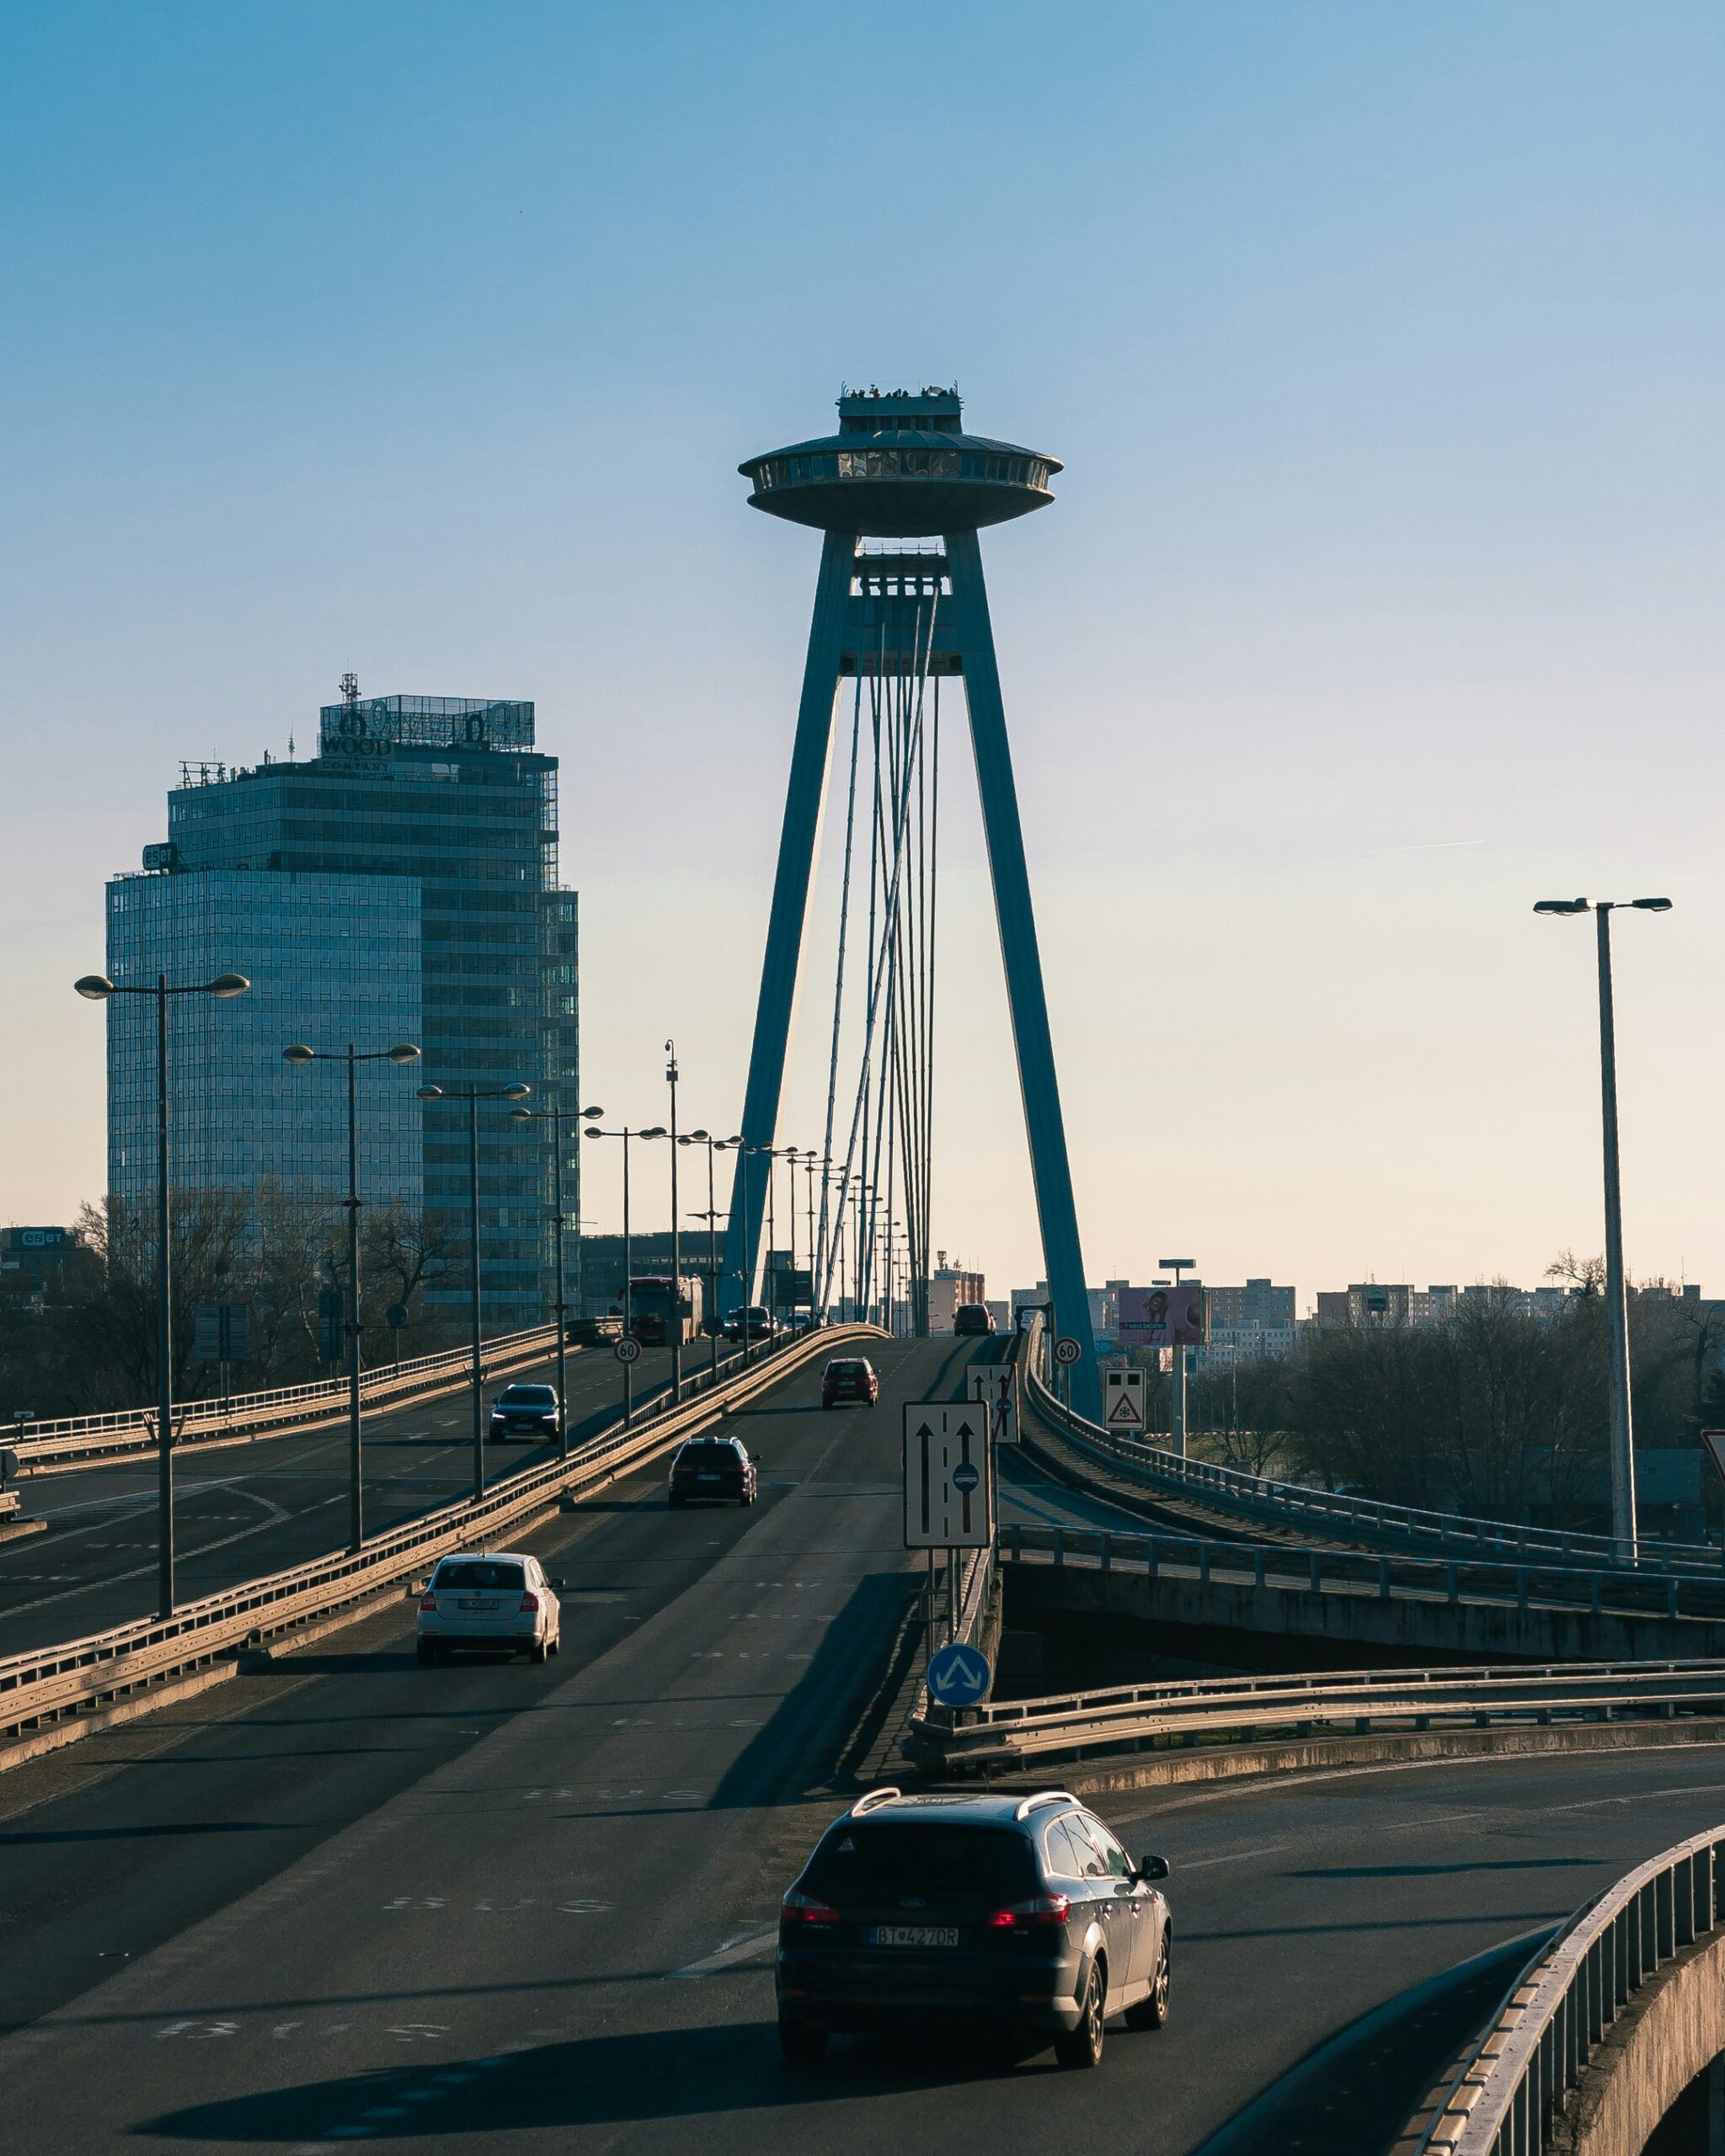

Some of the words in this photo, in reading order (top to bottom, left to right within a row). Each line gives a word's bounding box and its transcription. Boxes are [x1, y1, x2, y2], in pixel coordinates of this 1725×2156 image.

[321, 736, 392, 756] WOOD
[323, 760, 390, 771] COMPANY
[620, 1344, 634, 1357] 60
[1060, 1345, 1074, 1358] 60
[380, 1897, 614, 1913] BUS
